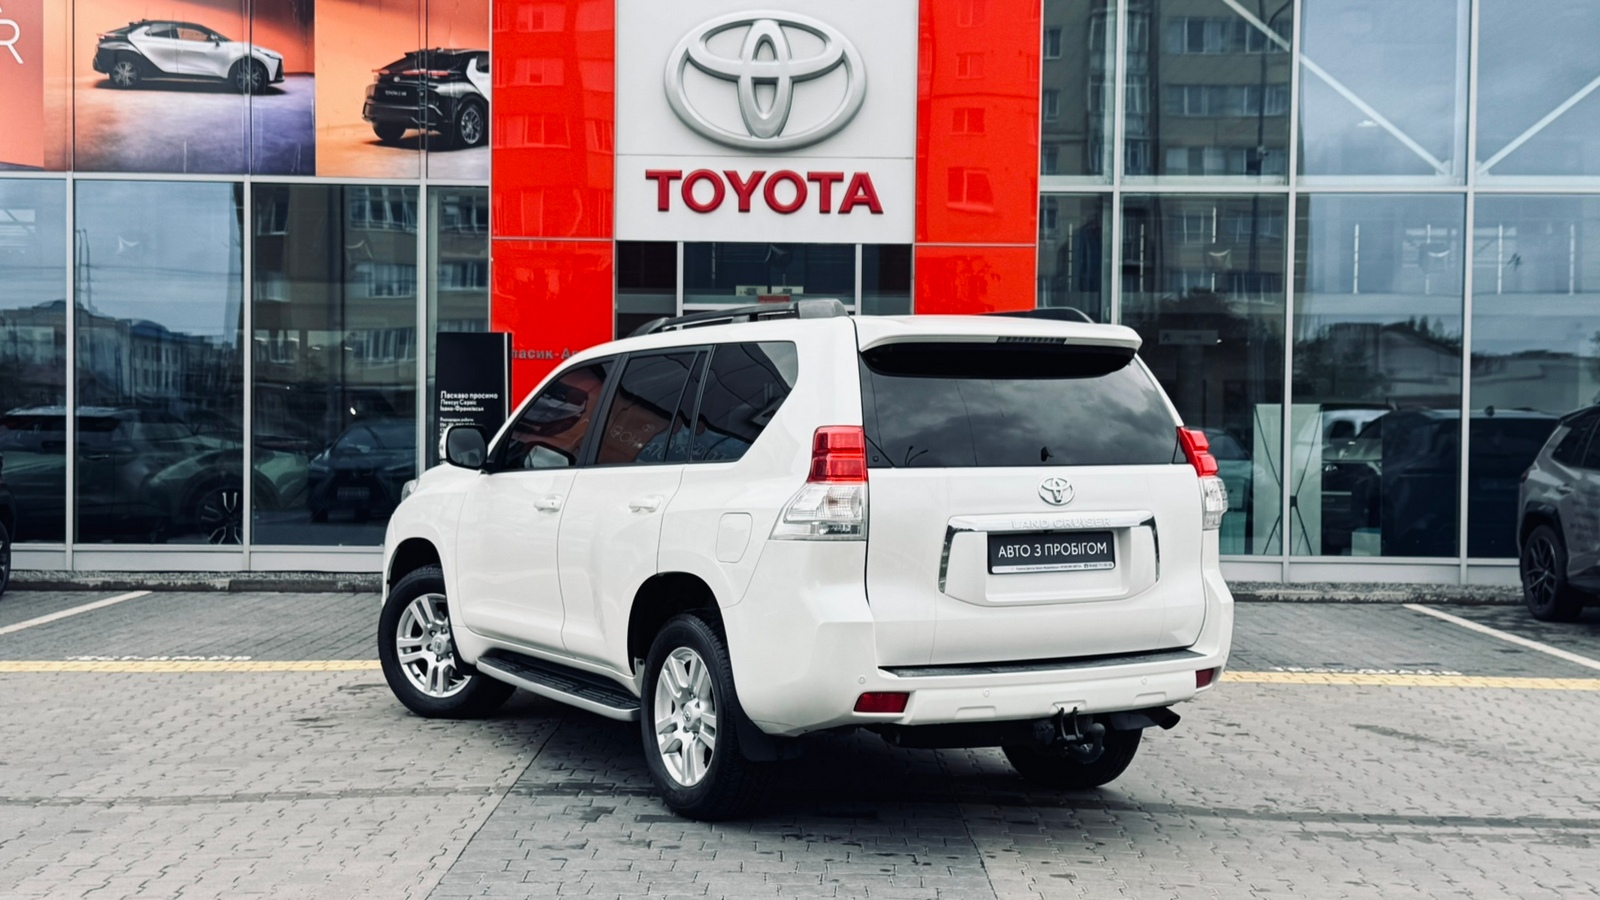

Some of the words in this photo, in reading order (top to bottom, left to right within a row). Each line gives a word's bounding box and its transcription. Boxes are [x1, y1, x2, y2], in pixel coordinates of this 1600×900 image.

[645, 169, 883, 214] TOYOTA
[1011, 519, 1050, 529] LAND
[1053, 518, 1111, 528] CRUISER
[998, 544, 1030, 558] АВТО
[1044, 542, 1107, 556] ПРОБІГОМ
